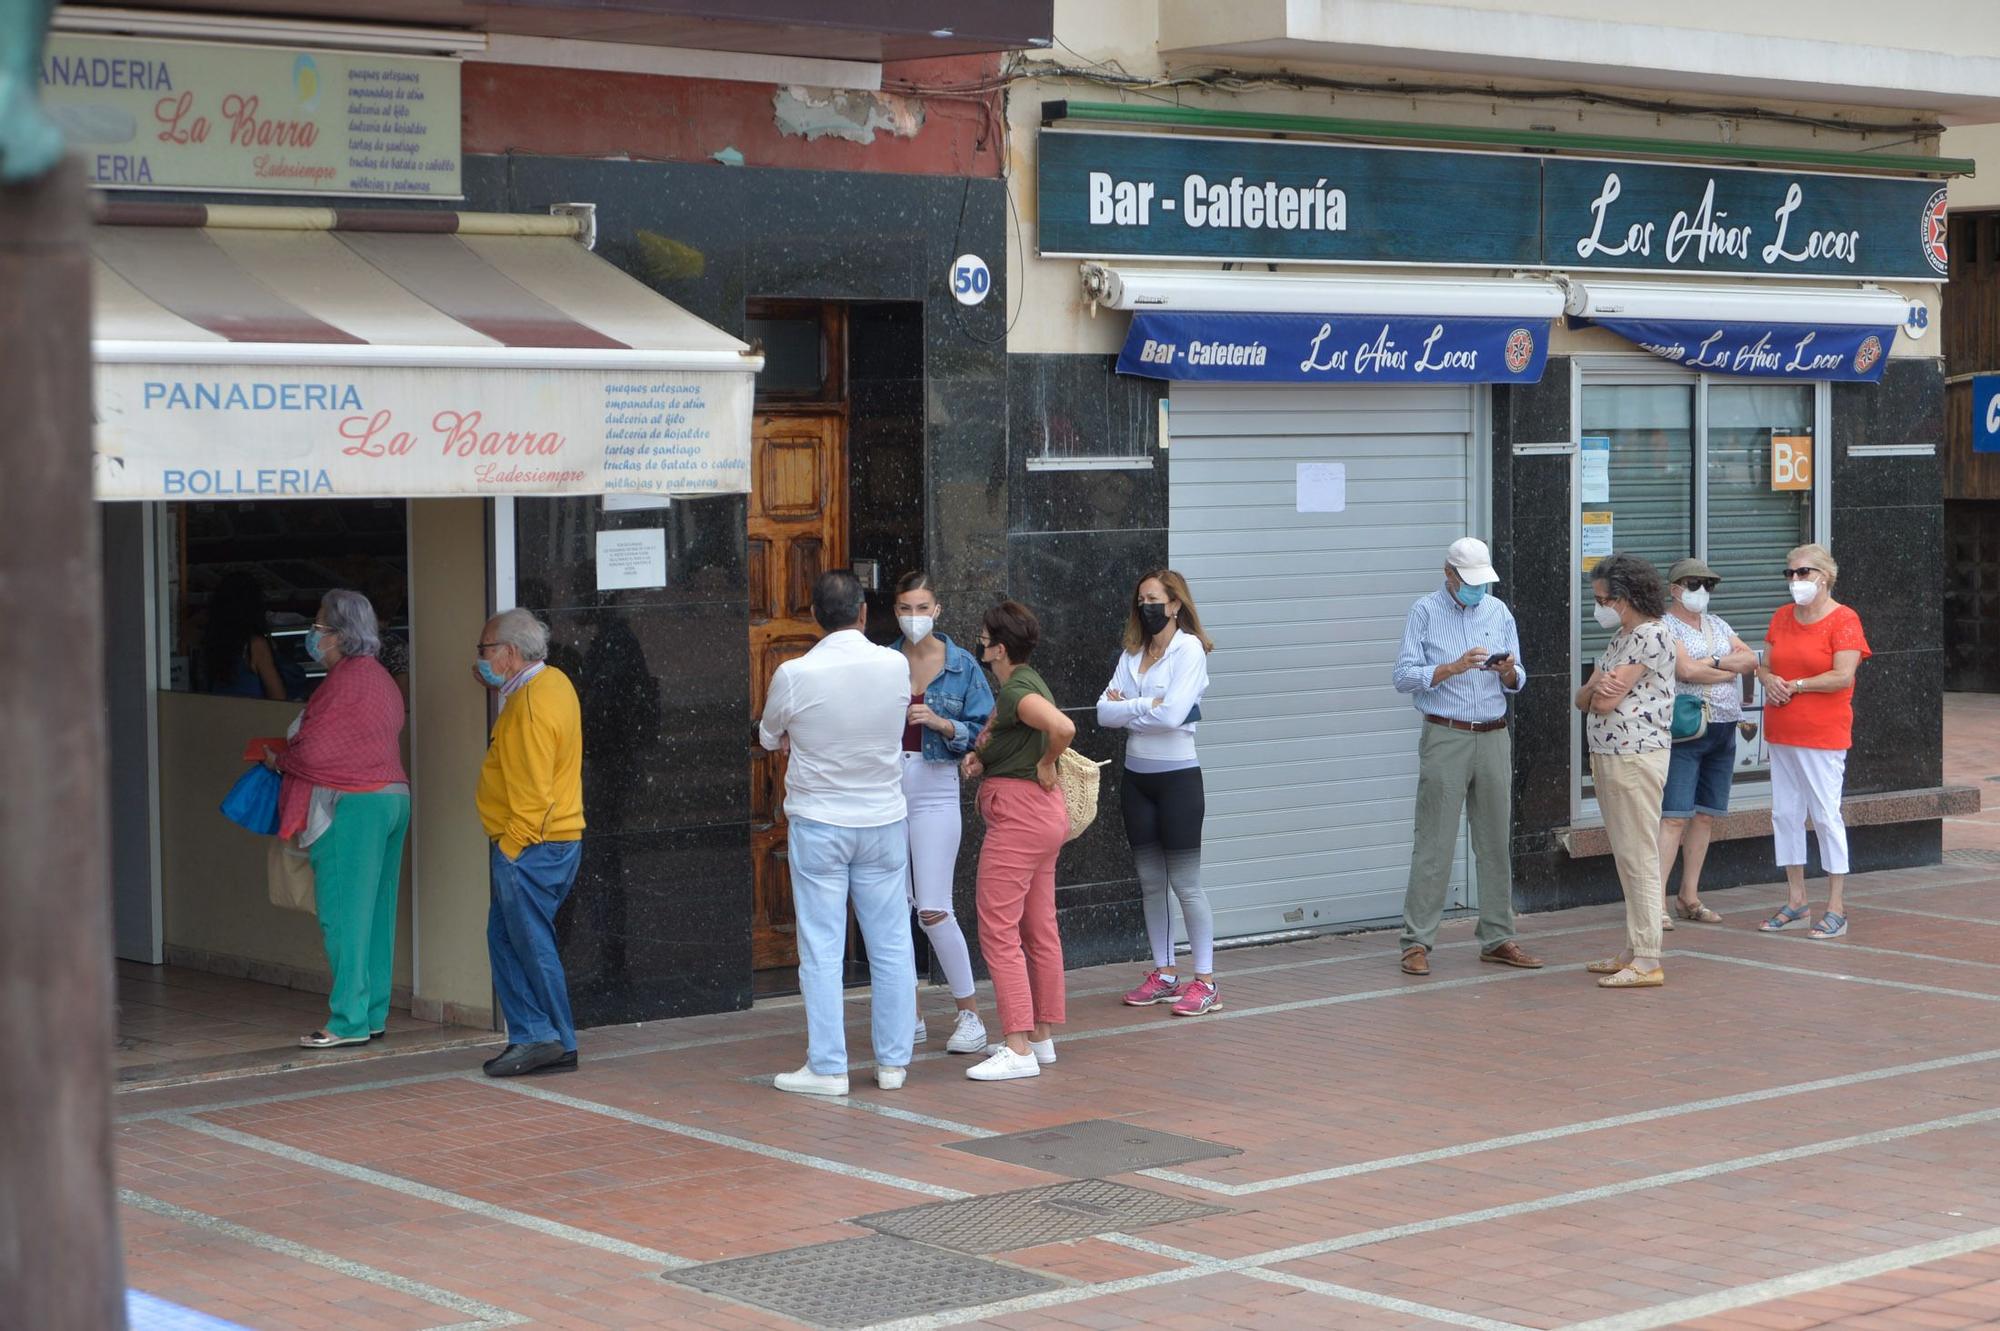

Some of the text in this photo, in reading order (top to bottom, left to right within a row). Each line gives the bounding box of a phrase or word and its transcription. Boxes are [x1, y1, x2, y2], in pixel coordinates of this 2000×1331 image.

[38, 55, 173, 91] ANADERIA
[155, 91, 320, 147] La Barra
[382, 121, 392, 133] de
[349, 138, 420, 154] tartas de santiago
[96, 154, 153, 182] ERIA
[380, 157, 389, 169] de
[391, 158, 416, 171] batata
[1089, 171, 1347, 231] Bar - Cafetería
[1577, 173, 1860, 264] Los Años Locos
[955, 267, 989, 294] 50
[1908, 307, 1928, 328] 48
[1140, 339, 1176, 364] Bar
[1188, 341, 1267, 366] Cafetería
[1300, 322, 1349, 371] Los
[1354, 324, 1408, 373] Años
[1414, 324, 1477, 372] Locos
[1685, 330, 1730, 366] Los
[1732, 331, 1781, 371] Años
[1785, 331, 1843, 372] Locos
[143, 381, 364, 411] PANADERIA
[605, 382, 701, 395] queques artesanos
[605, 398, 665, 411] empanadas
[668, 398, 680, 410] de
[650, 413, 663, 425] al
[665, 413, 685, 427] kilo
[338, 409, 567, 458] La Barra
[650, 428, 662, 440] de
[664, 428, 710, 441] hojaldre
[605, 443, 701, 458] tartas de santiago
[473, 464, 588, 485] Ladesiempre
[603, 459, 642, 472] truchas
[645, 459, 658, 471] de
[661, 459, 697, 471] batata
[701, 462, 708, 470] o
[163, 468, 335, 494] BOLLERIA
[605, 477, 719, 490] milhojas y palmeras
